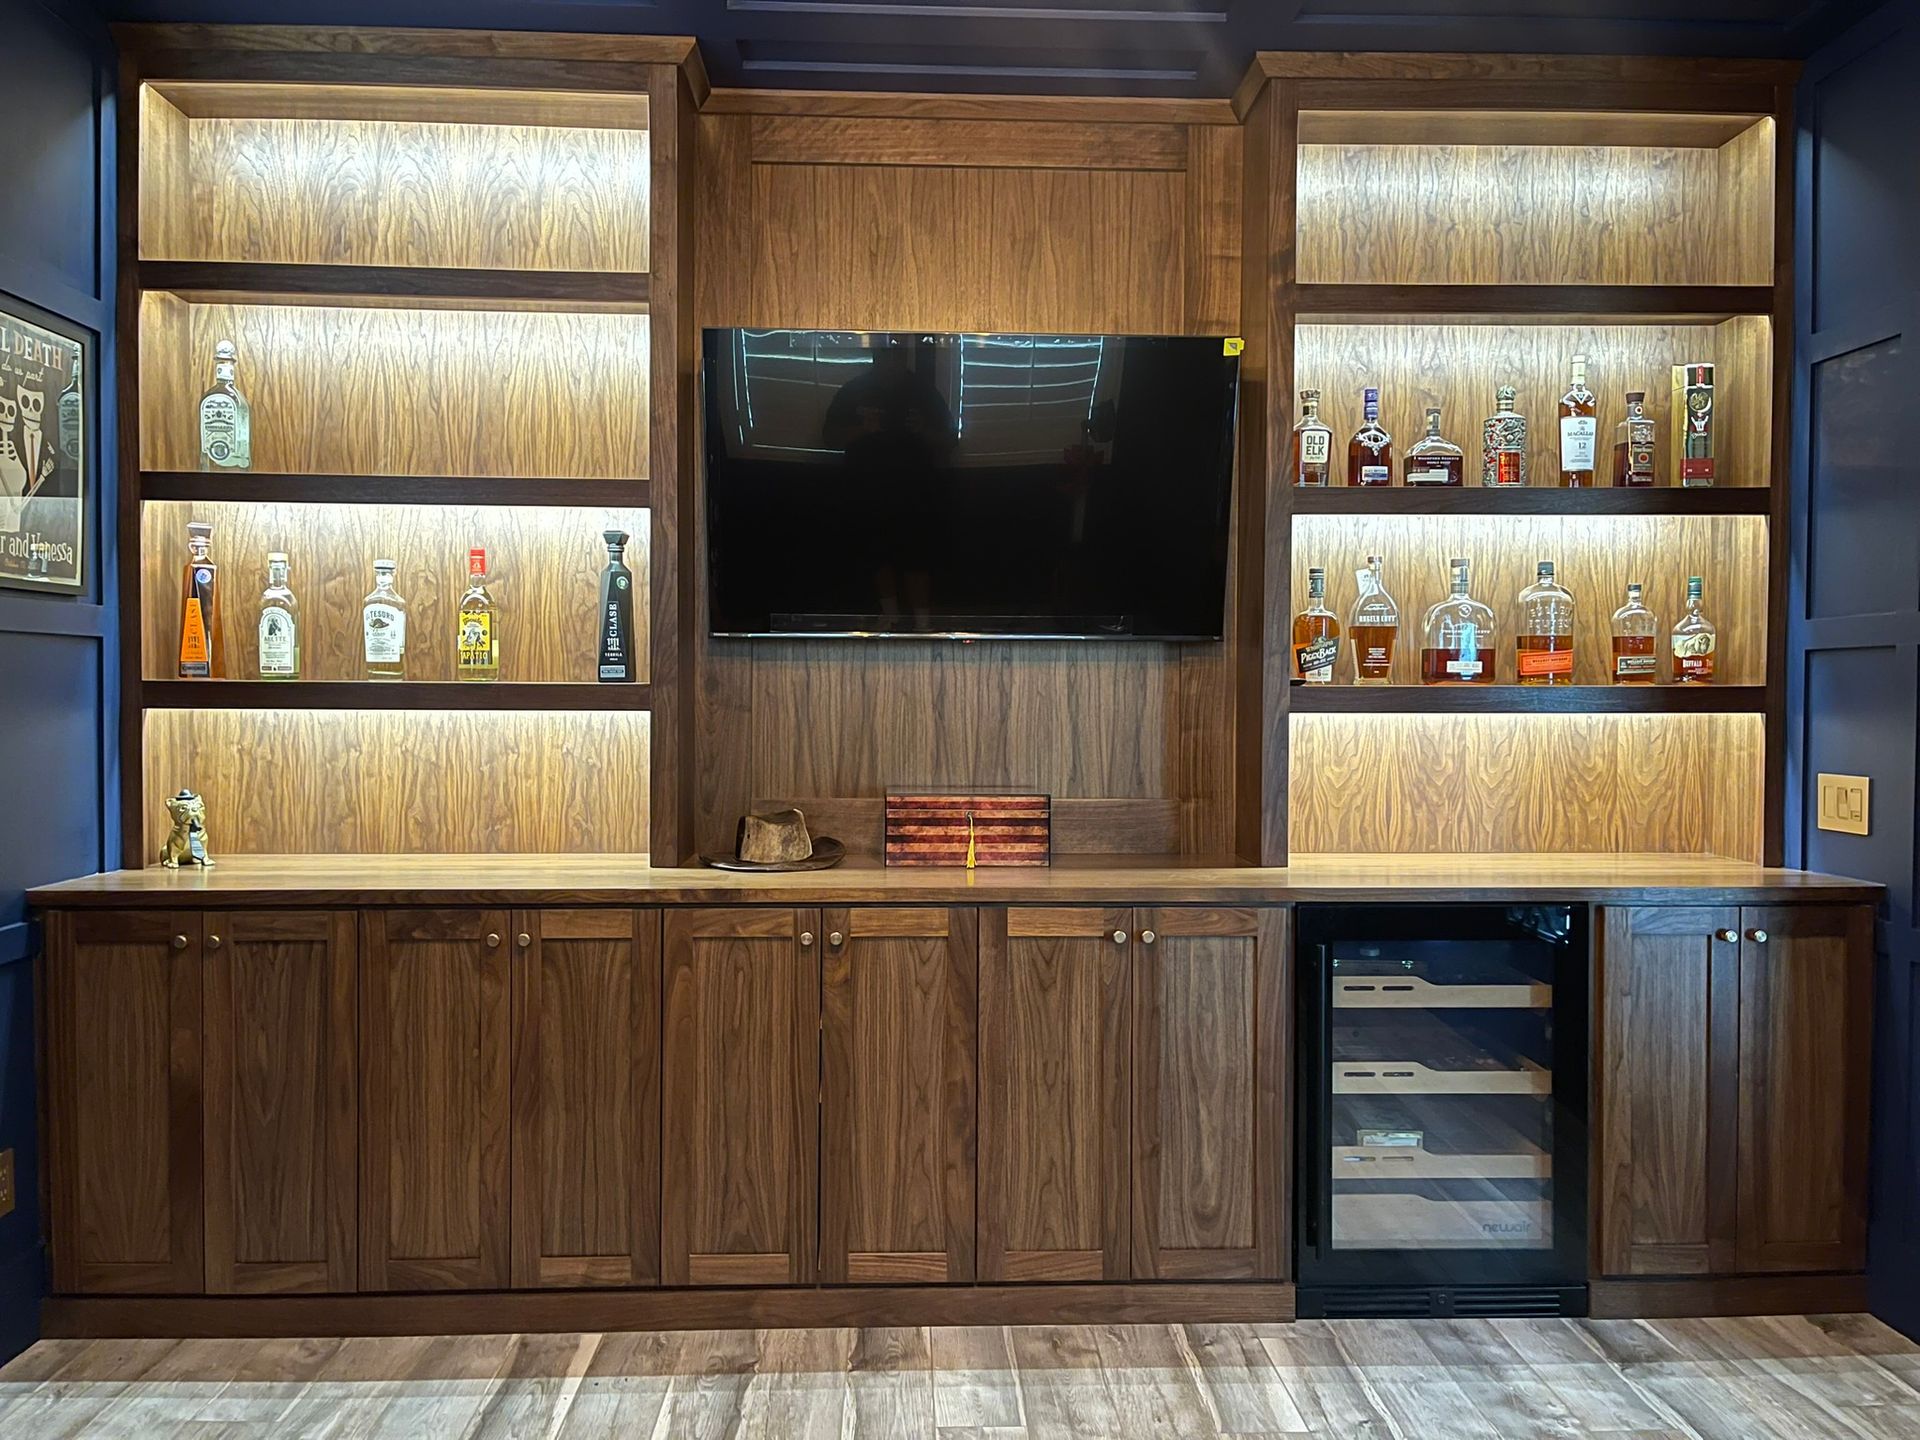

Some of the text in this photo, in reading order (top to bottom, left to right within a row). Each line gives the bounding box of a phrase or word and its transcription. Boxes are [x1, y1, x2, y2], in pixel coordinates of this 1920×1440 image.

[13, 330, 63, 371] DEATH
[22, 367, 45, 387] part
[1306, 435, 1325, 446] OLD
[1305, 446, 1325, 456] ELK
[9, 532, 29, 558] and
[31, 532, 73, 565] Vanessa
